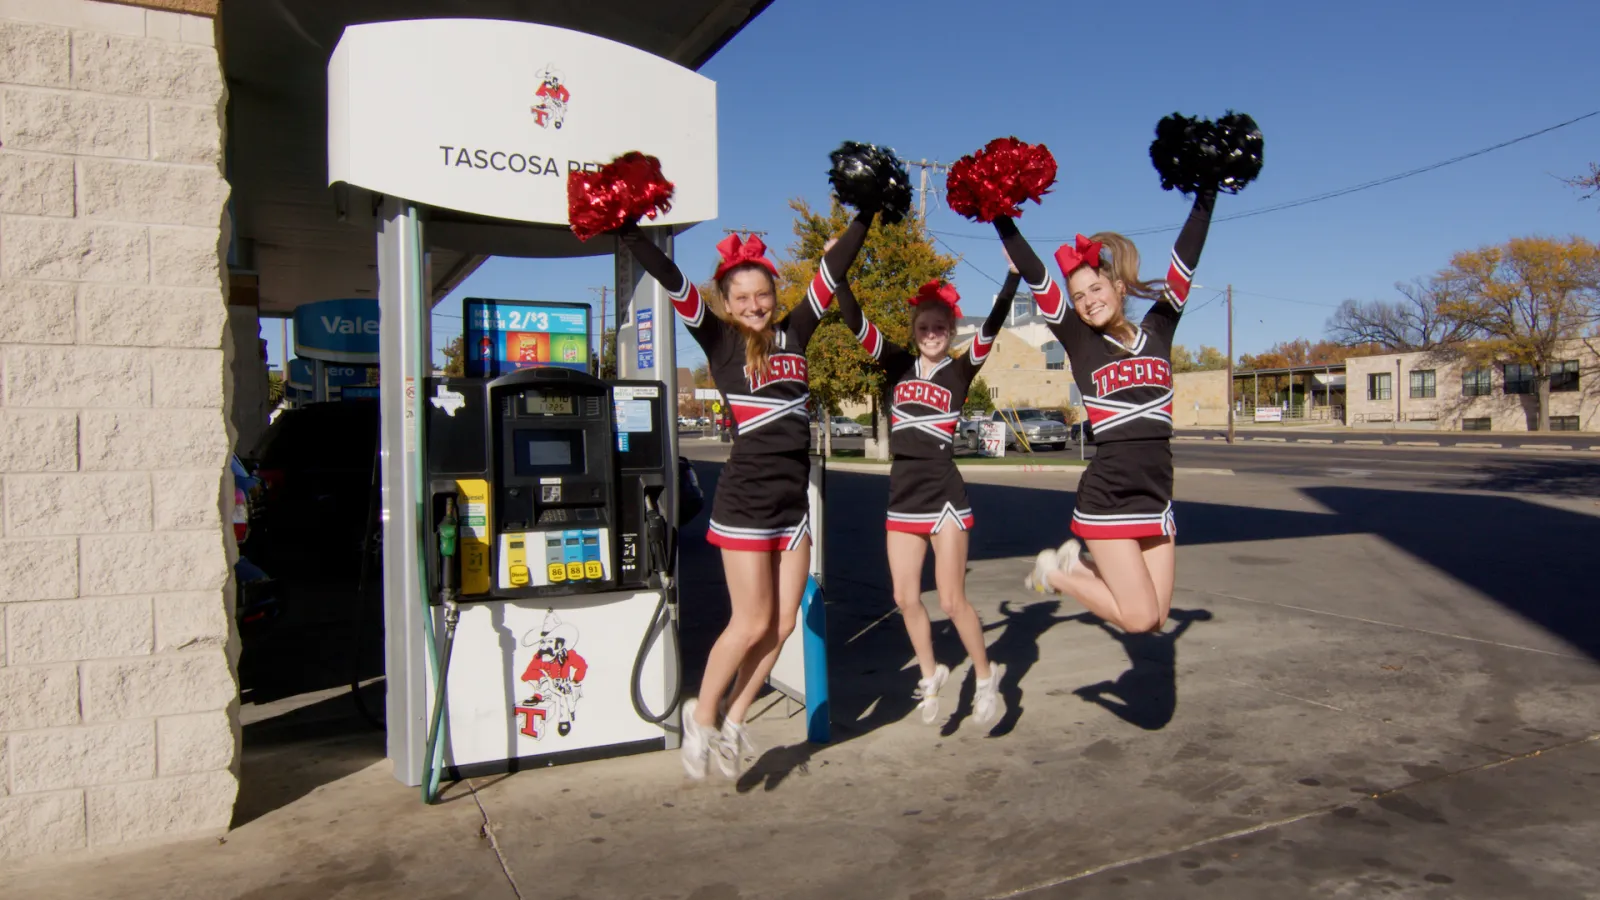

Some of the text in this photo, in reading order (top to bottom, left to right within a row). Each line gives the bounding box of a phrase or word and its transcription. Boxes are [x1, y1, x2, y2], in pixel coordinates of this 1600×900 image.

[439, 145, 560, 177] TASCOSA
[320, 315, 379, 335] Vale
[508, 310, 549, 331] 2/$3
[304, 364, 355, 377] Vero
[552, 568, 563, 576] 86
